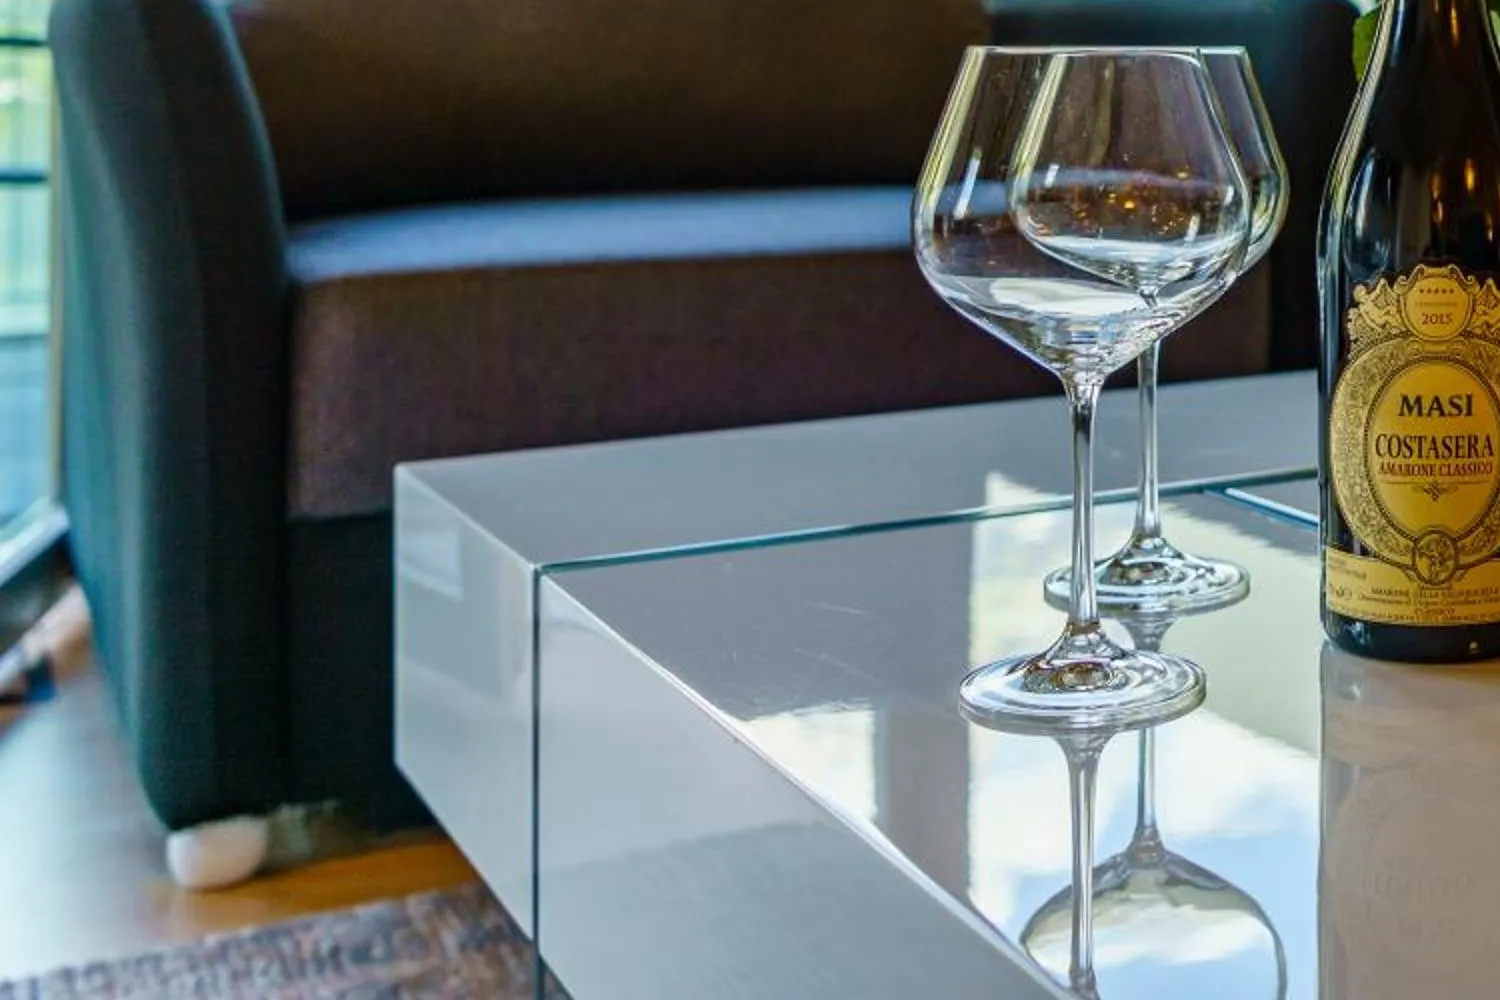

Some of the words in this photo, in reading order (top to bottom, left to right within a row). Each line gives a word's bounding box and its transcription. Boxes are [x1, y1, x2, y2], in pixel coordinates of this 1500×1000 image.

[1421, 312, 1454, 326] 2015
[1398, 393, 1473, 418] MASI
[1375, 433, 1494, 459] COSTASERA
[1379, 461, 1437, 477] AMARONE
[1439, 461, 1493, 477] CLASSICO
